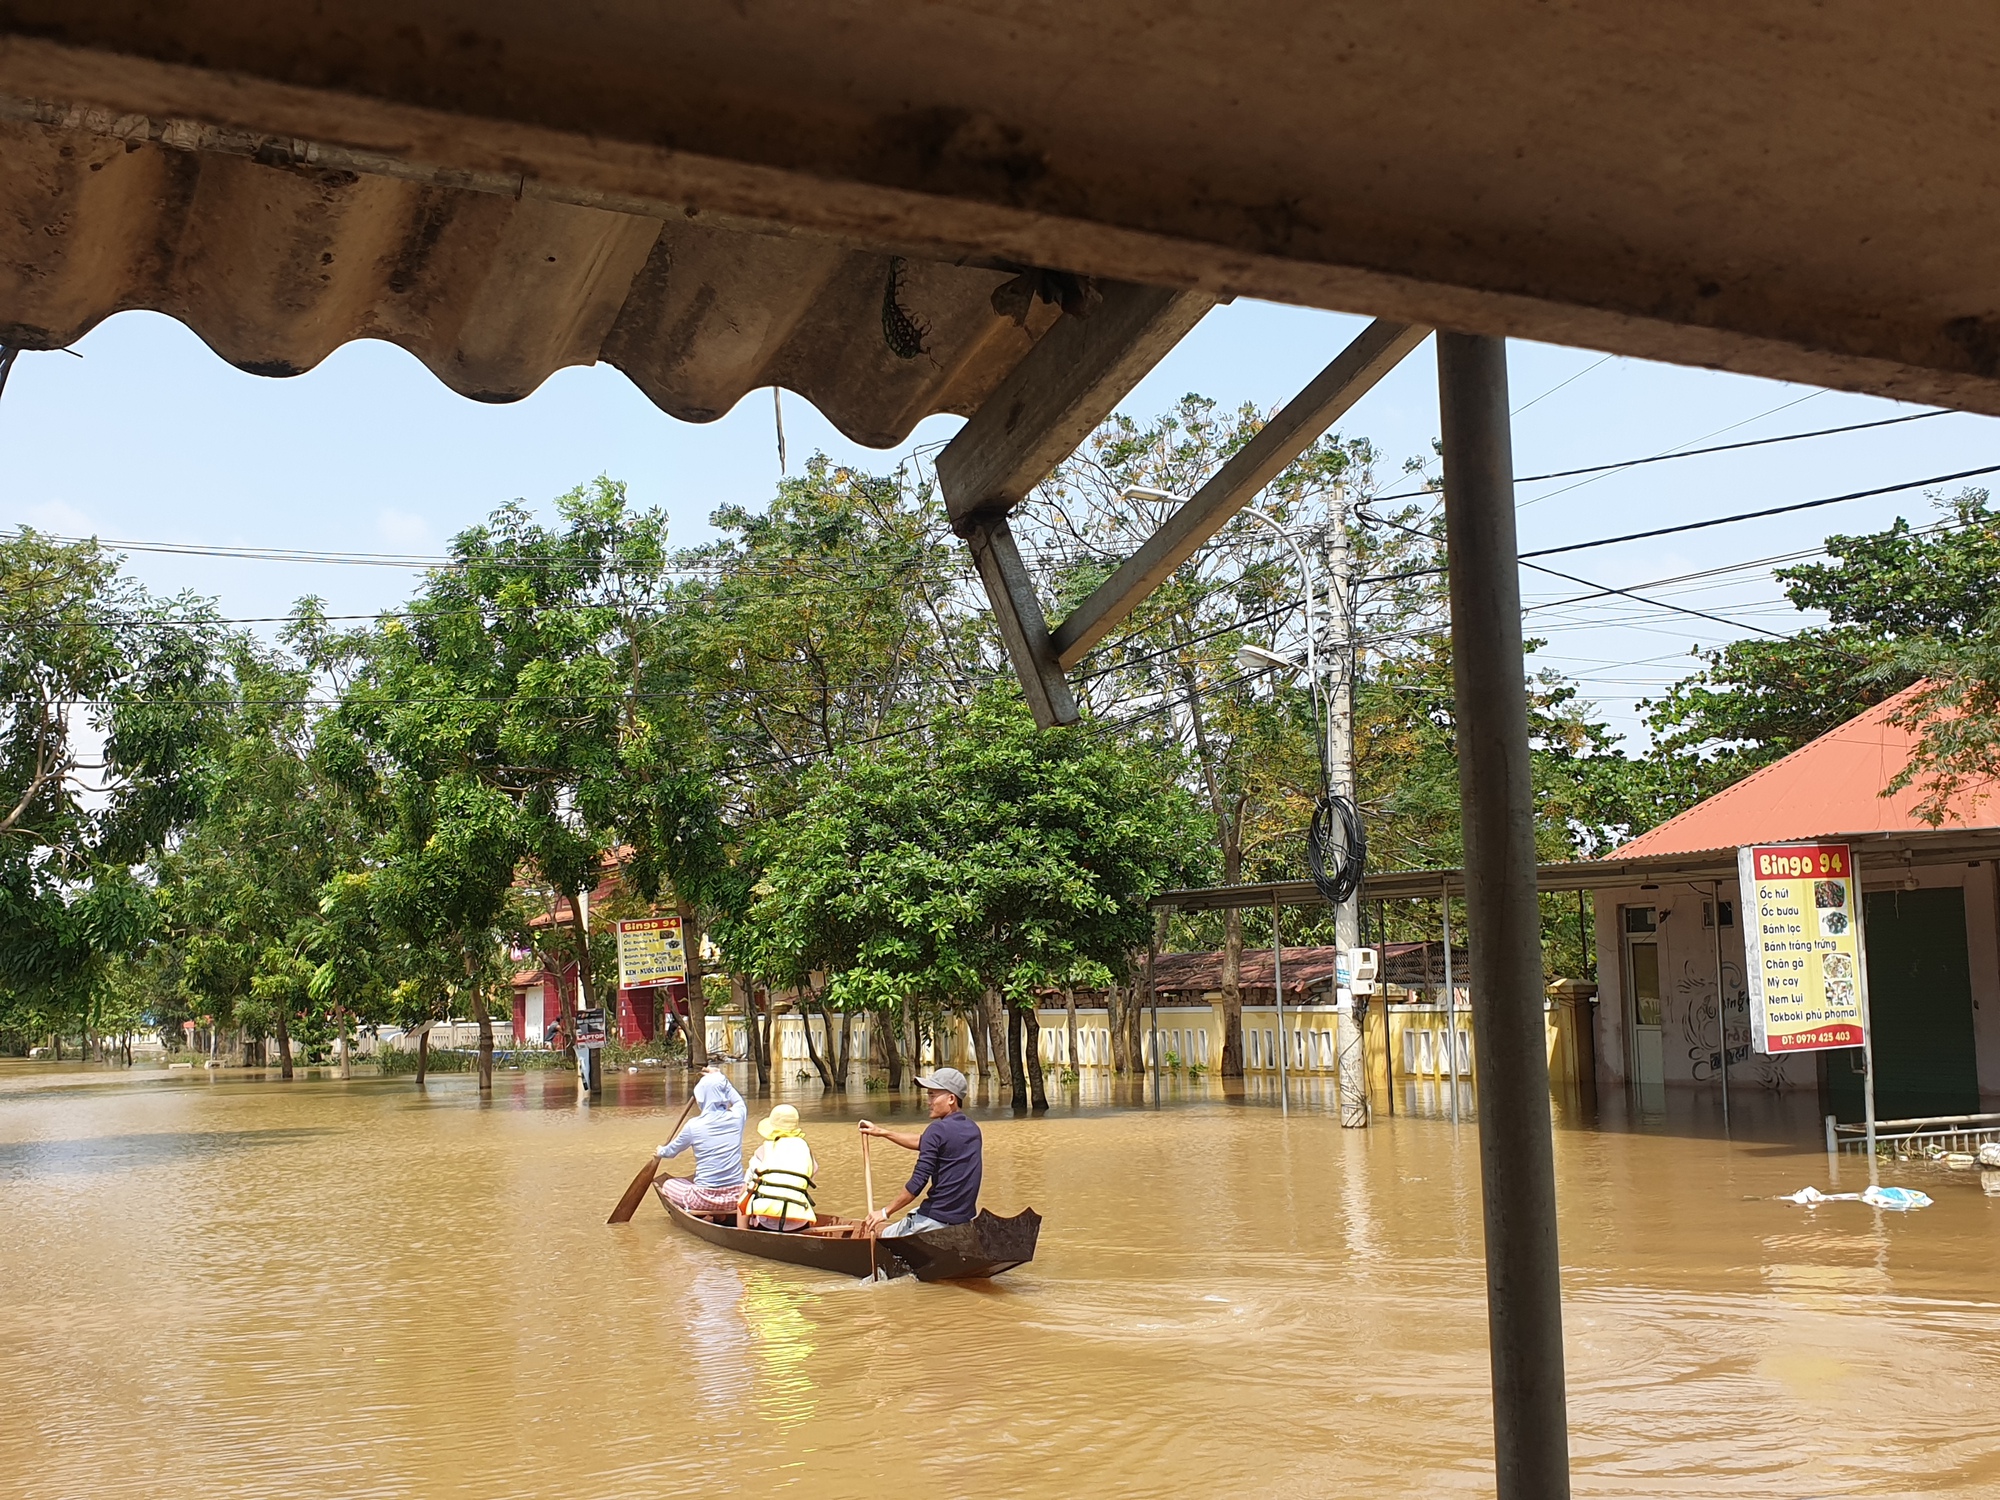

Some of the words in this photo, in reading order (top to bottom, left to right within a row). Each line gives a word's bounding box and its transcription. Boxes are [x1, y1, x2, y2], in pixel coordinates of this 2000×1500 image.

[1760, 854, 1813, 877] Bingo
[1820, 852, 1842, 873] 94
[1760, 885, 1773, 899] Ốc
[1775, 888, 1789, 899] hút
[1761, 903, 1774, 917] Ốc
[1777, 907, 1799, 916] bươu
[624, 922, 658, 931] Bingo
[662, 919, 677, 927] 94
[1763, 923, 1785, 934] Bánh
[1787, 924, 1801, 936] lọc
[1764, 940, 1787, 952] Bánh
[1789, 940, 1811, 952] tráng
[1814, 938, 1837, 951] trứng
[1766, 958, 1789, 969] Chân
[1792, 957, 1804, 970] gà
[1767, 976, 1780, 988] Mỳ
[1782, 978, 1799, 988] cay
[1769, 995, 1789, 1005] Nem
[1791, 993, 1803, 1006] Lụi
[1769, 1011, 1803, 1023] Tokboki
[1806, 1008, 1822, 1022] phủ
[1824, 1007, 1857, 1020] phomai
[1781, 1036, 1794, 1045] ĐT:
[1796, 1034, 1817, 1044] 0979
[1818, 1032, 1834, 1042] 425
[1835, 1031, 1851, 1041] 403
